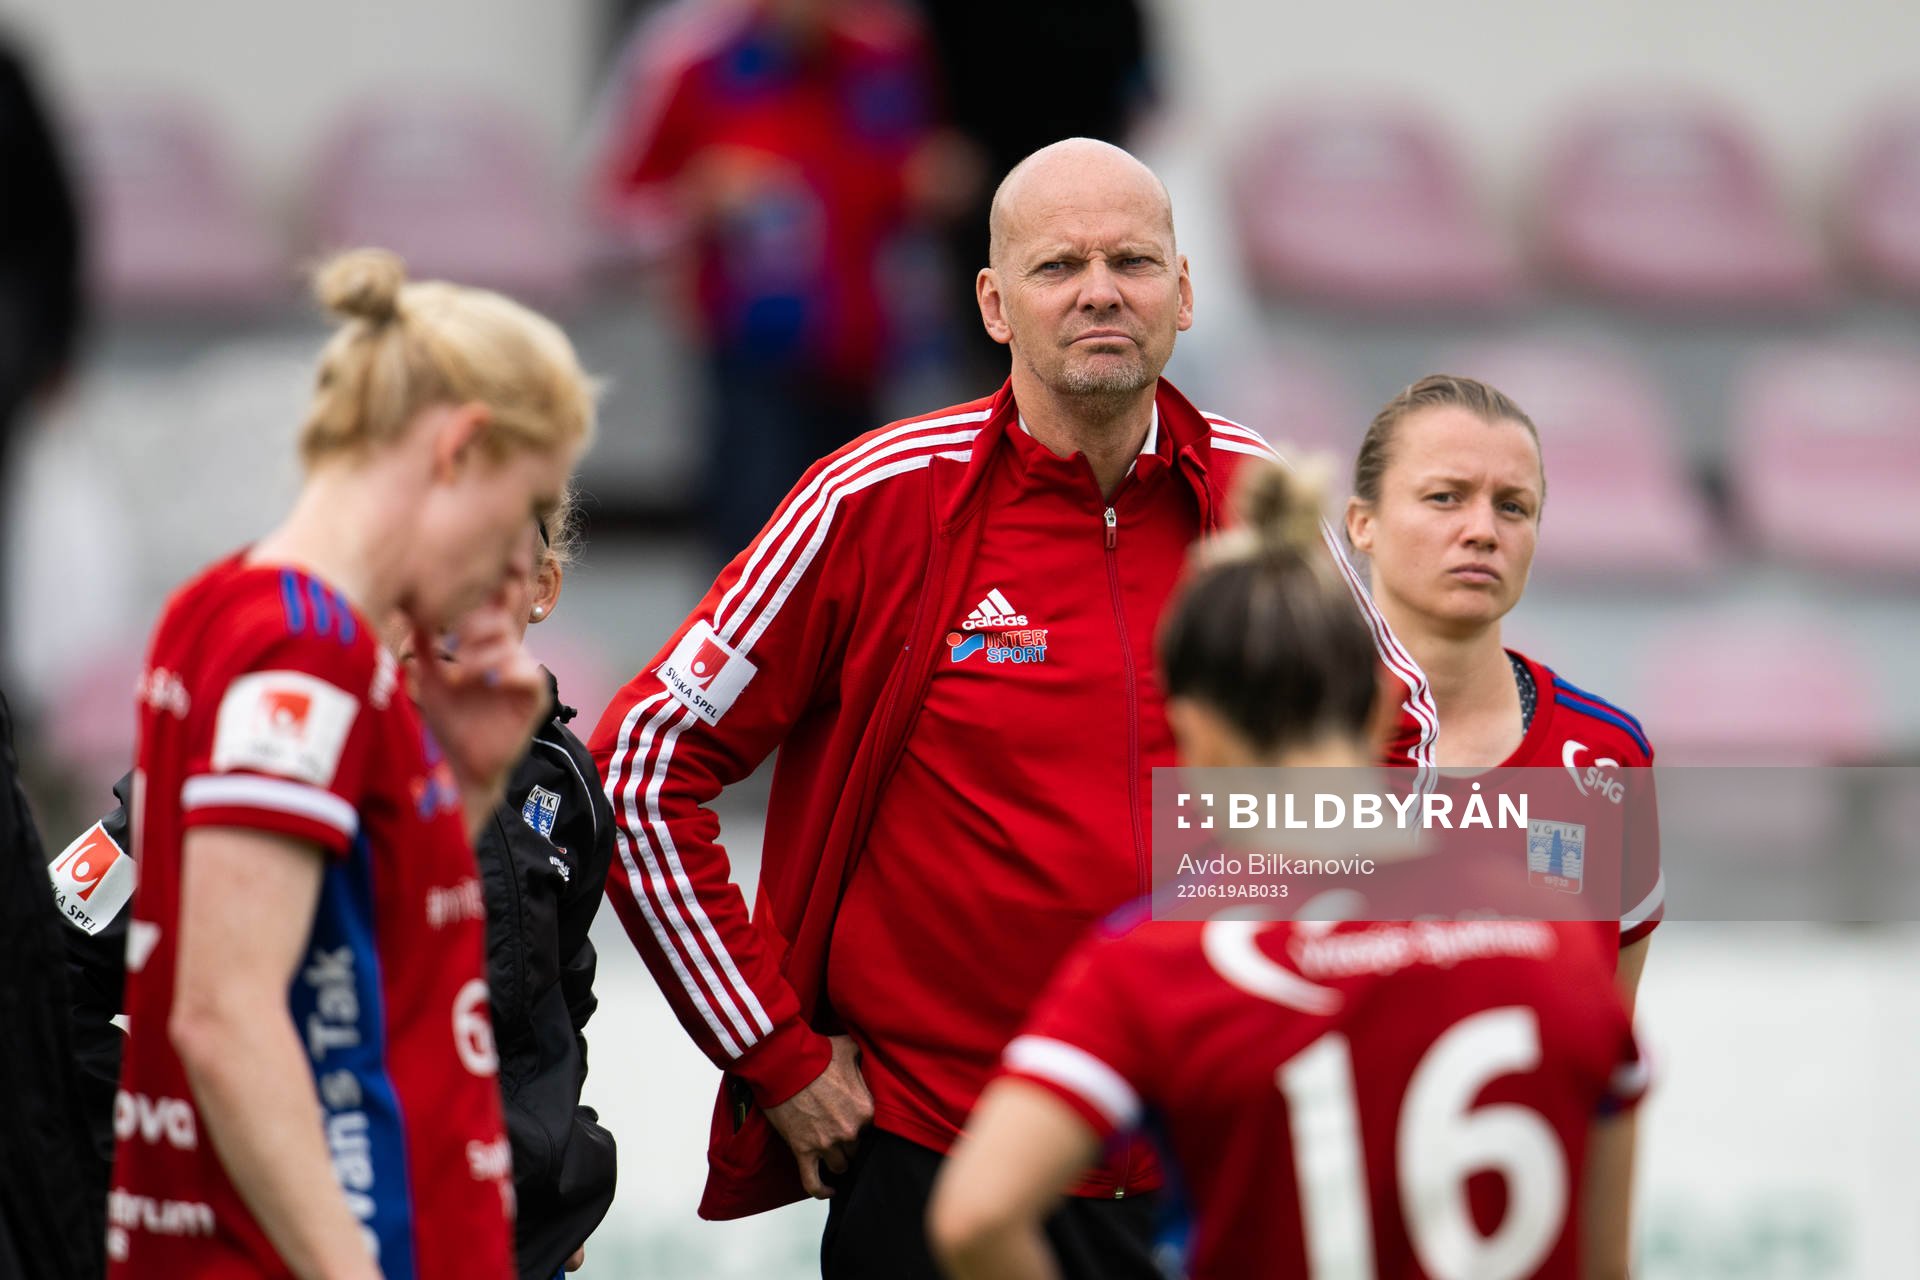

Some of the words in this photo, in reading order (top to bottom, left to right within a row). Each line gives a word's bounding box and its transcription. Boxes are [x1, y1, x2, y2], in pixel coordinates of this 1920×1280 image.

[962, 614, 1028, 630] adidas
[986, 630, 1047, 648] INTER
[986, 645, 1047, 663] SPORT
[693, 694, 718, 719] SPEL
[1583, 766, 1625, 804] SHG
[304, 944, 361, 1062] Tak
[1277, 1004, 1571, 1280] 16
